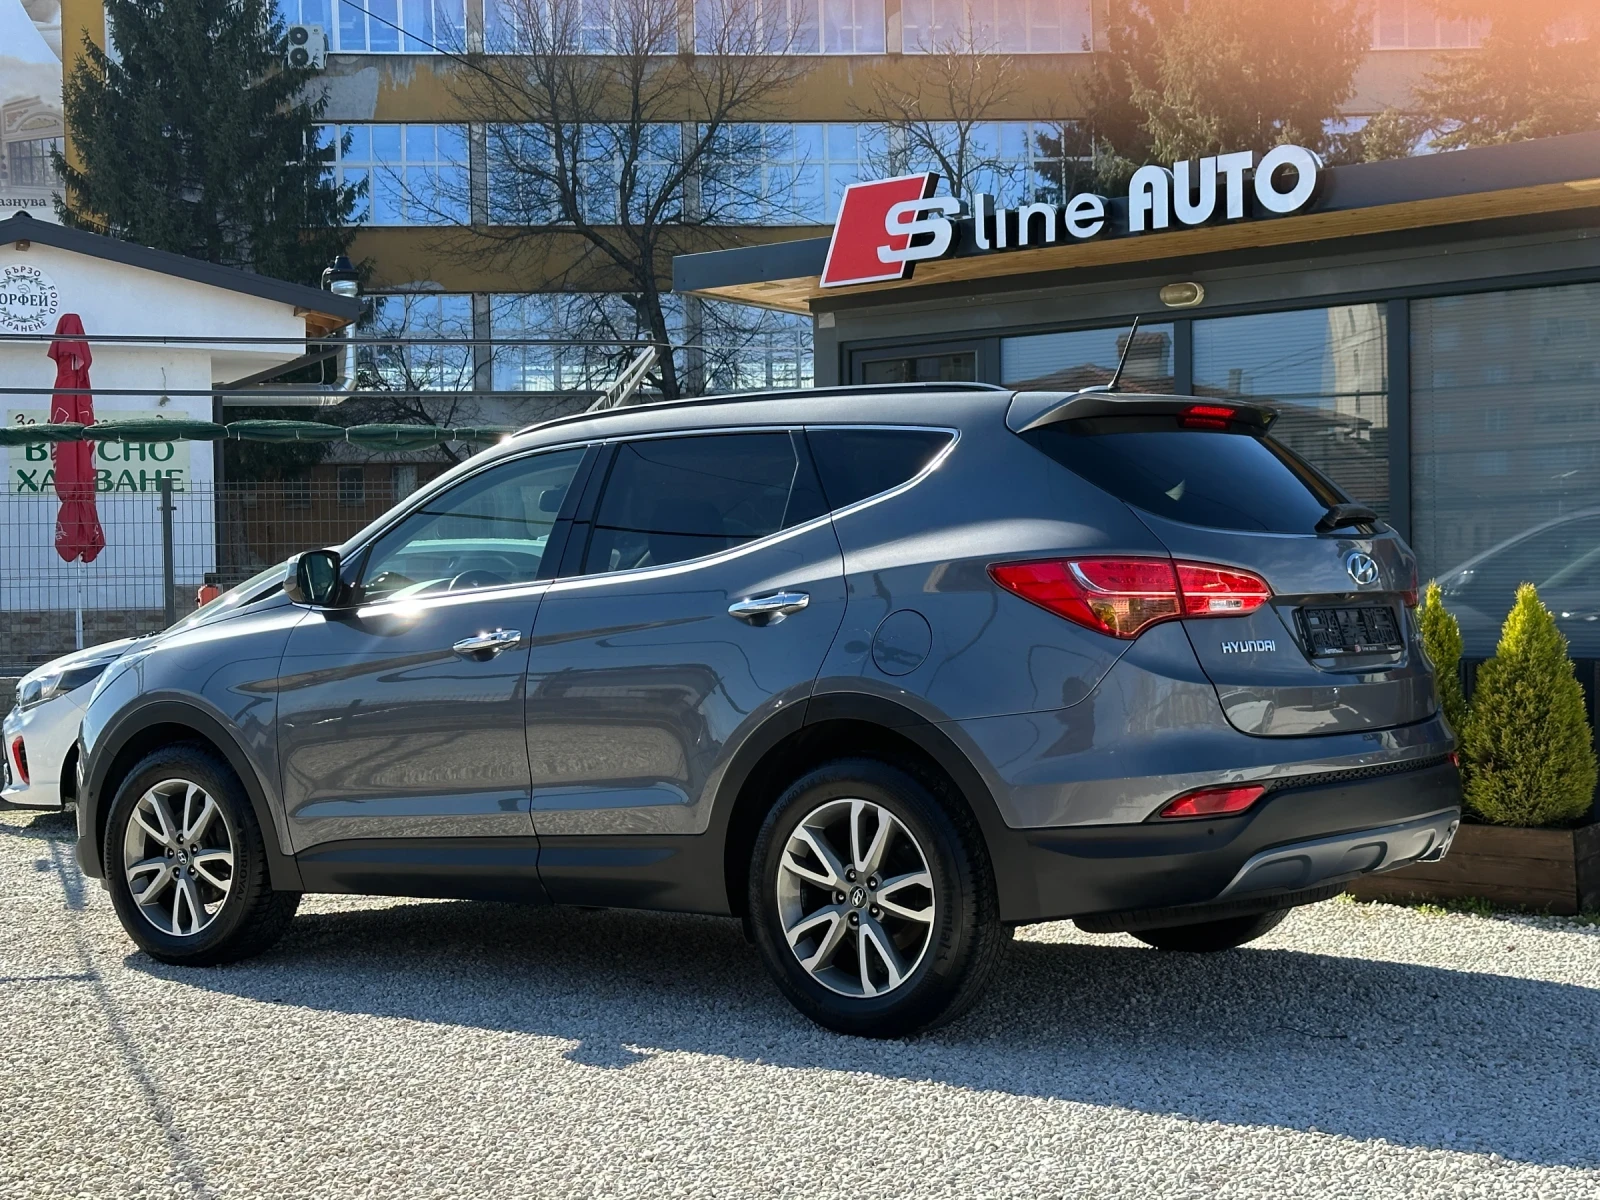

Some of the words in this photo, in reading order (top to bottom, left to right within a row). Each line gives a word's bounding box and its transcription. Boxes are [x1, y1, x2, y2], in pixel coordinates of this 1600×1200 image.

[876, 198, 965, 264] S
[974, 192, 1105, 250] line
[1128, 144, 1322, 233] AUTO
[4, 265, 41, 276] БЪРЗО
[0, 291, 48, 307] ОРФЕЙ
[48, 285, 58, 314] FOOD
[0, 317, 48, 332] ХРАНЕНЕ
[26, 441, 175, 462] ВСНО
[16, 469, 185, 492] ХАВАНЕ
[1221, 640, 1276, 654] HYUNDAI
